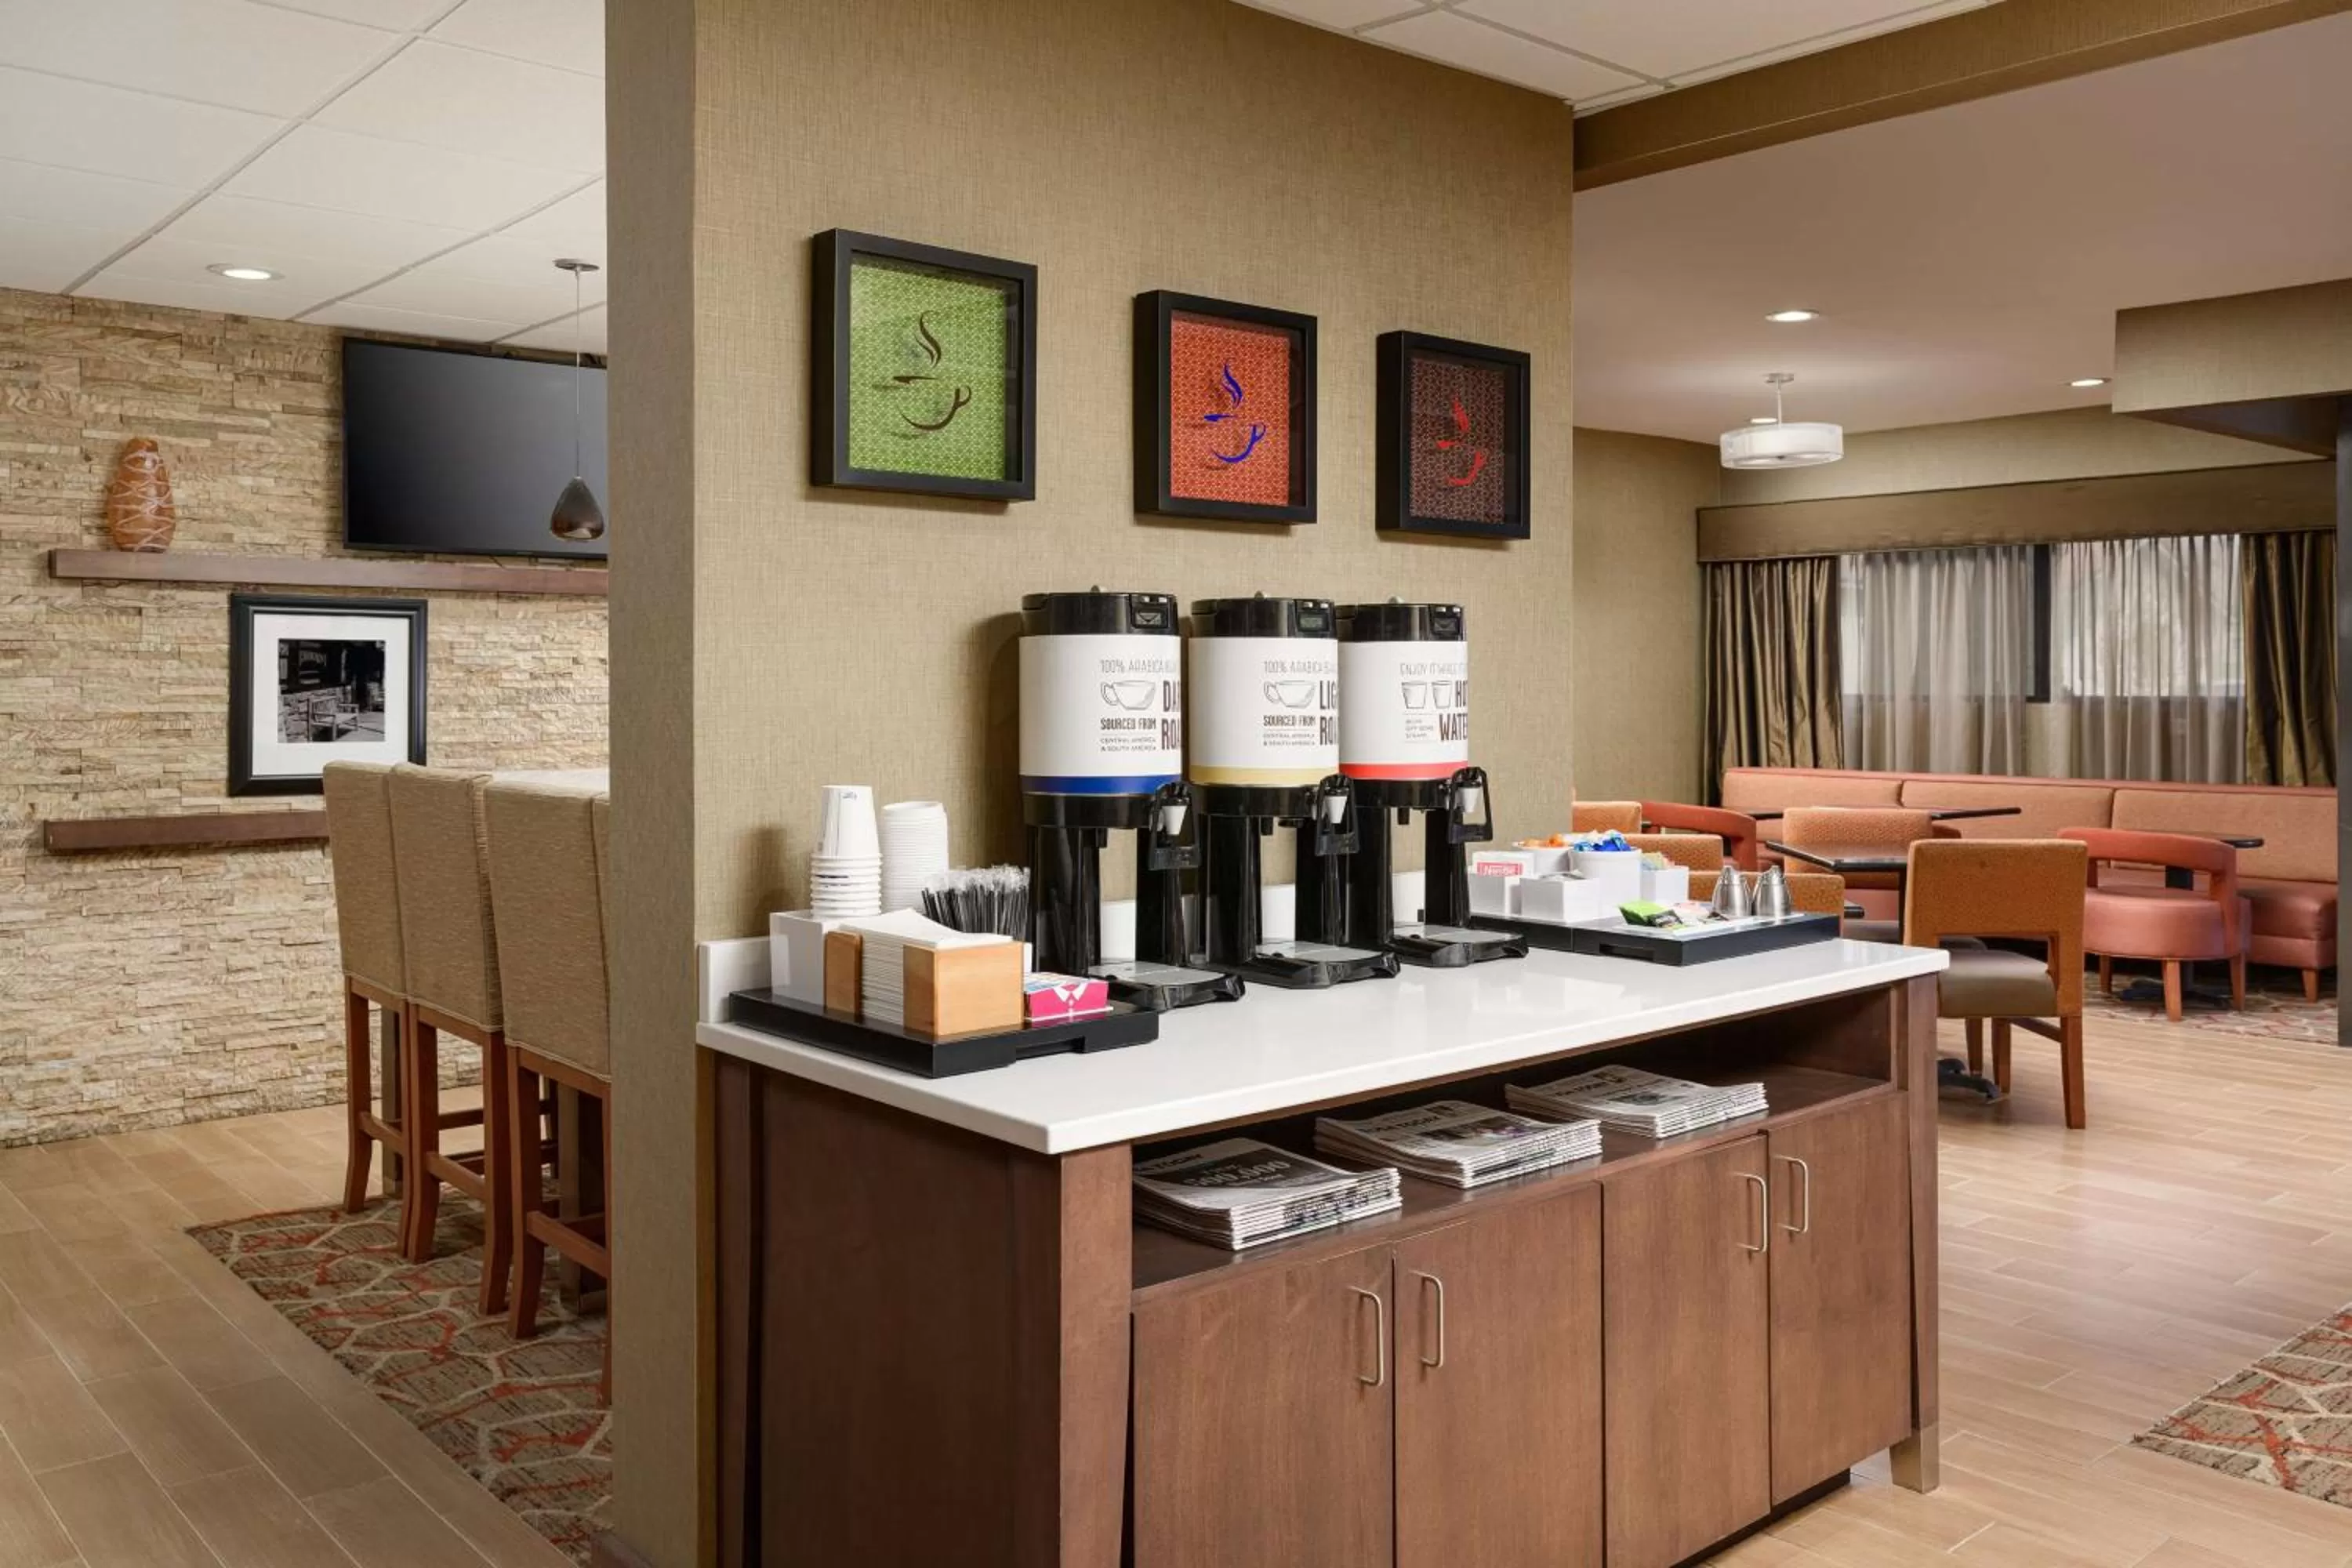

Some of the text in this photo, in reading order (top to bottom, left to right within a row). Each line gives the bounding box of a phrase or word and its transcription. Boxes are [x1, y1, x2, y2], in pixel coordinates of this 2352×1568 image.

[1101, 659, 1124, 673] 100%
[1264, 660, 1287, 673] 100%
[1100, 718, 1156, 730] SOURCED FROM
[1263, 715, 1316, 727] SOURCED FROM
